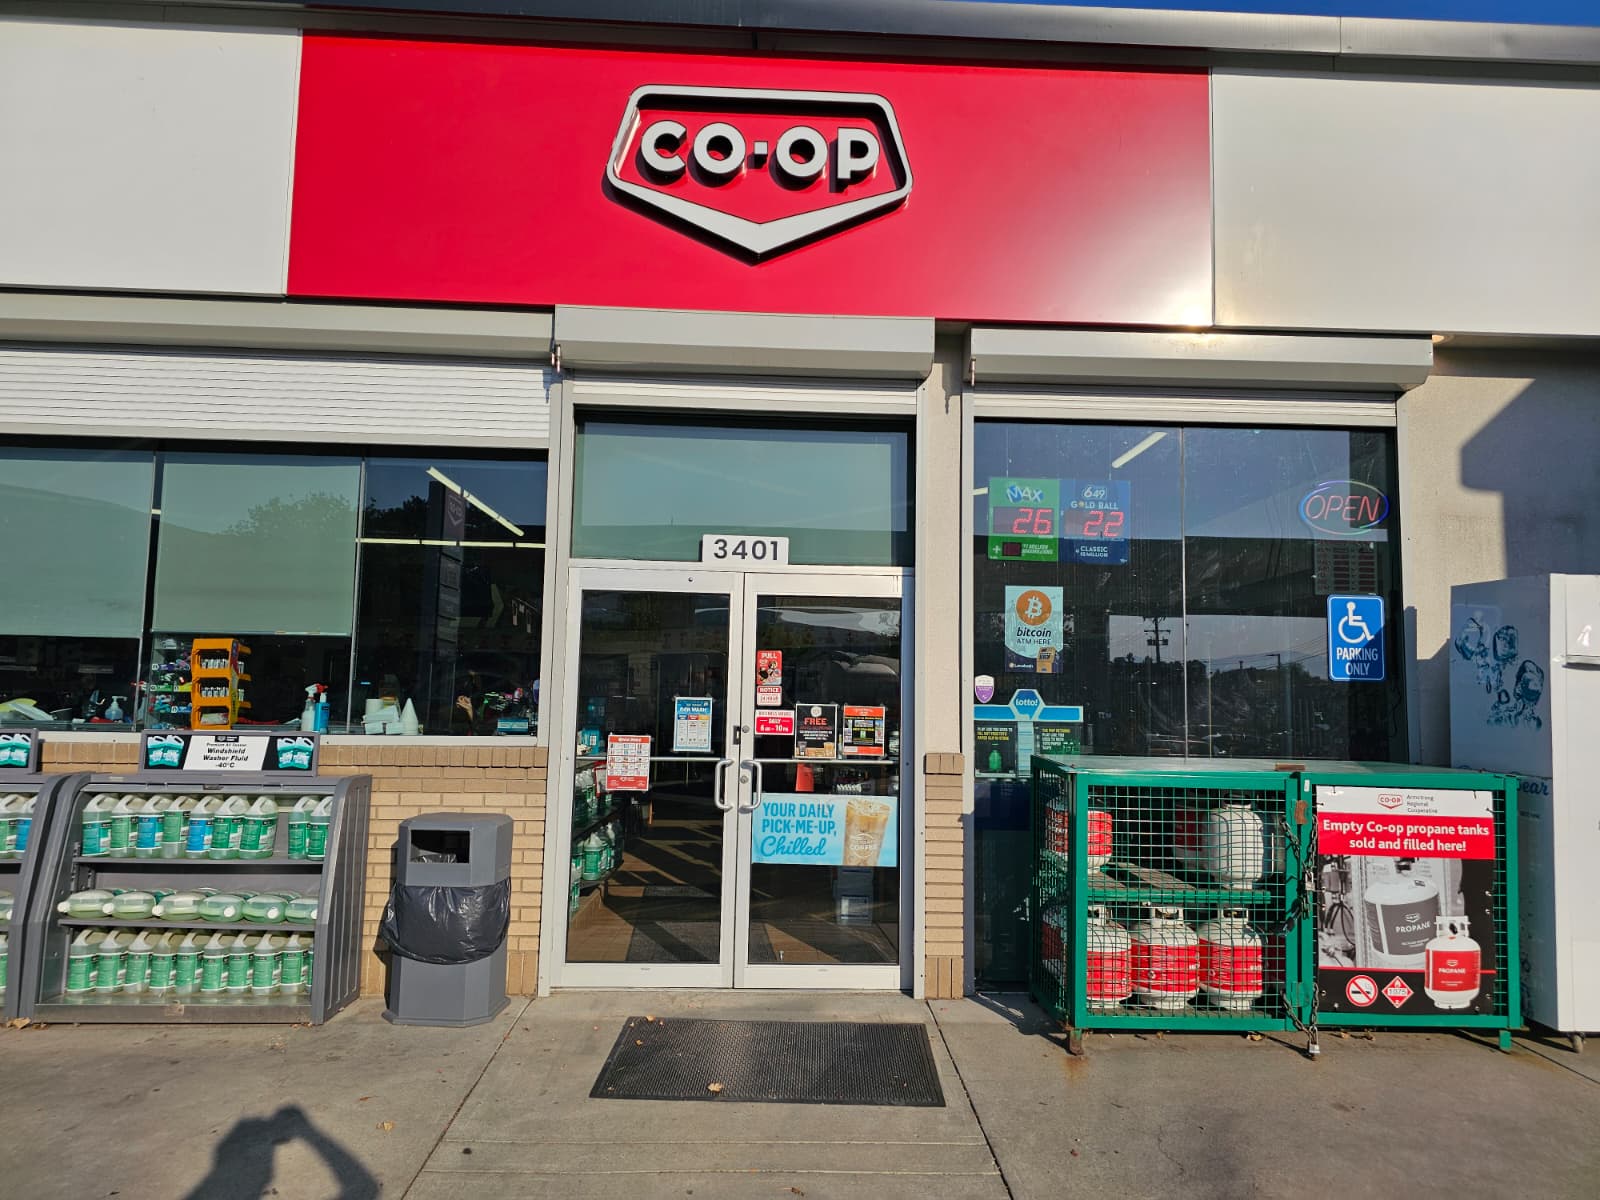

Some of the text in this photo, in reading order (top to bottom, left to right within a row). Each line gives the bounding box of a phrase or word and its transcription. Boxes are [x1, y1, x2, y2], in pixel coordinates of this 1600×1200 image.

[641, 120, 880, 180] CO-OP
[1007, 485, 1043, 502] MAX
[1083, 487, 1105, 498] 649
[1070, 501, 1118, 510] GOLD BALL
[1305, 495, 1381, 521] OPEN
[1012, 508, 1052, 534] 26
[1083, 511, 1124, 537] 22
[713, 538, 778, 561] 3401
[1017, 627, 1051, 637] bitcoin
[1336, 647, 1378, 661] PARKING
[1345, 662, 1370, 676] ONLY
[804, 717, 827, 726] FREE
[762, 802, 835, 818] YOUR DAILY
[761, 818, 837, 837] PICK-ME-UP,
[1323, 819, 1489, 837] Empty Co-op propane tanks
[760, 835, 826, 857] Chilled
[1349, 838, 1467, 852] sold and filled here!
[1395, 921, 1430, 933] PROPANE
